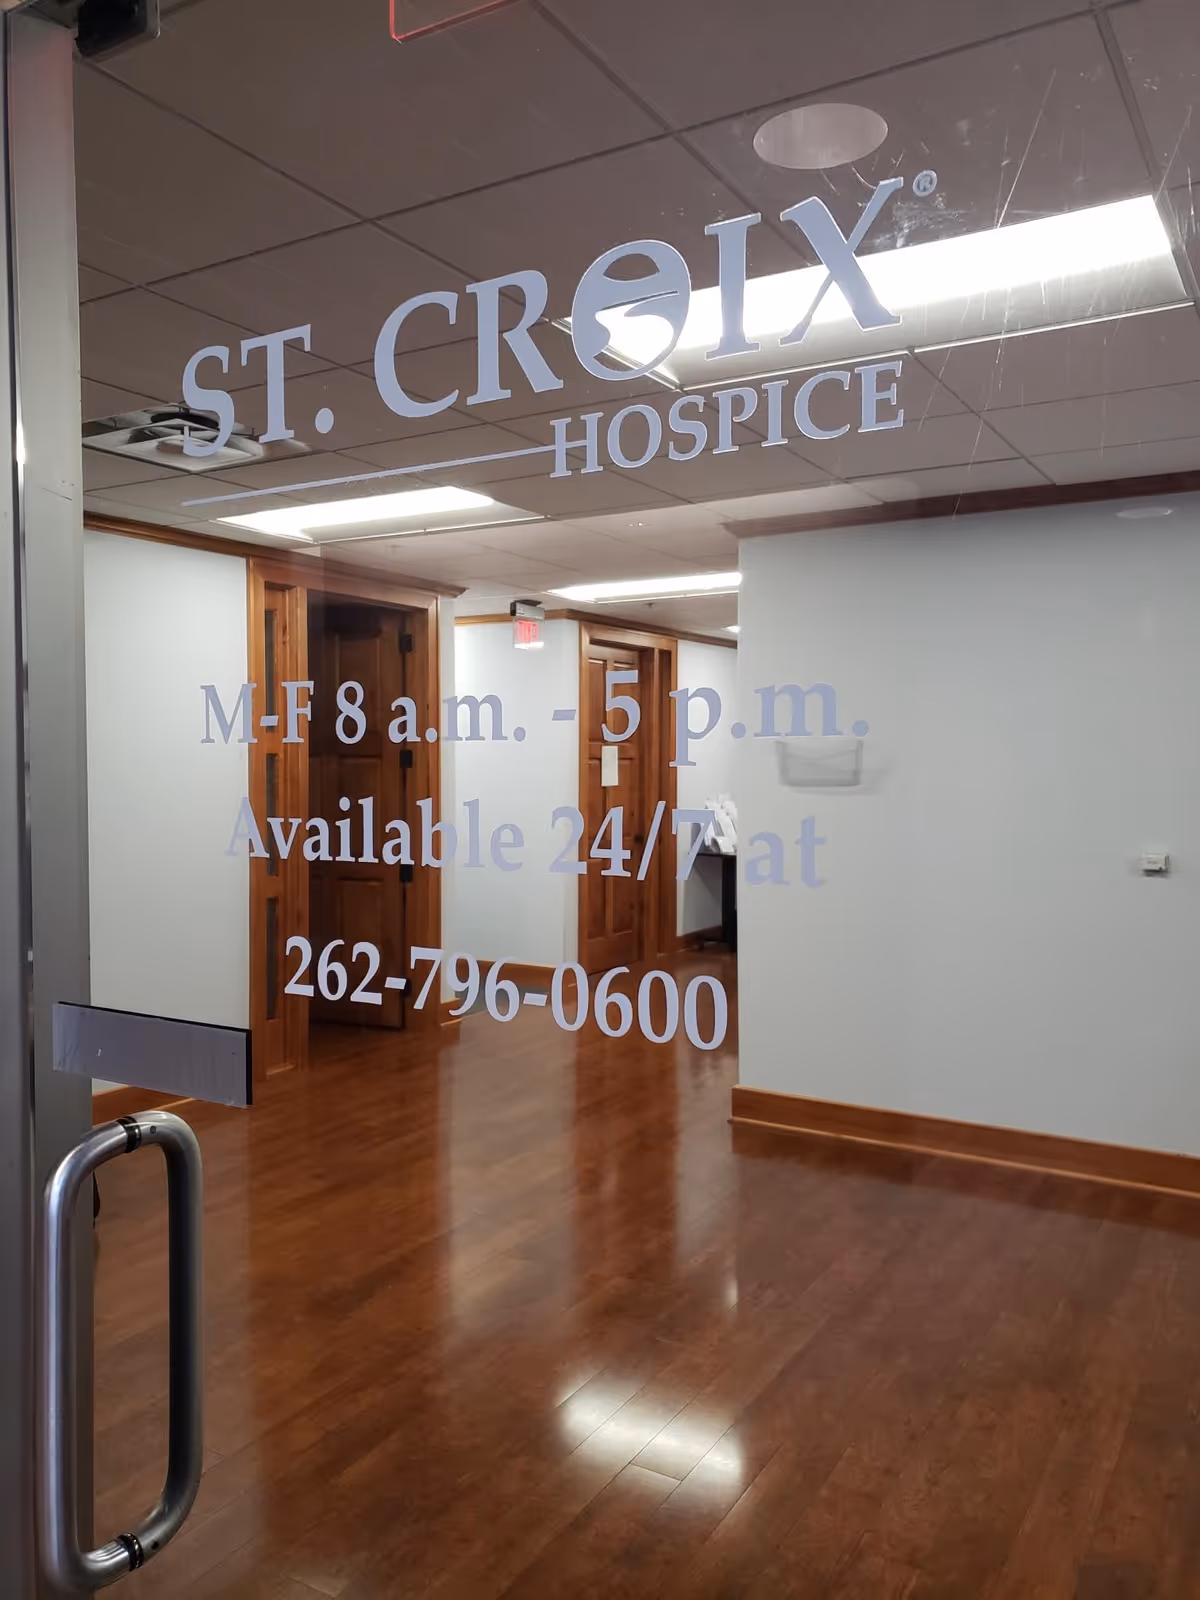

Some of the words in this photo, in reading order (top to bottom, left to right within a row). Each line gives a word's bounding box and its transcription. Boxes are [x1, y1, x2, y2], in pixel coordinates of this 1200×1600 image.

[181, 323, 335, 458] ST.
[550, 360, 905, 479] HOSPICE
[200, 680, 315, 745] M-F
[335, 680, 367, 745] 8
[387, 691, 526, 744] a.m.
[601, 669, 642, 743] 5
[668, 679, 870, 768] p.m.
[225, 796, 525, 872] Available
[549, 800, 716, 881] 24/7
[743, 814, 828, 888] at
[284, 935, 729, 1051] 262-796-0600
